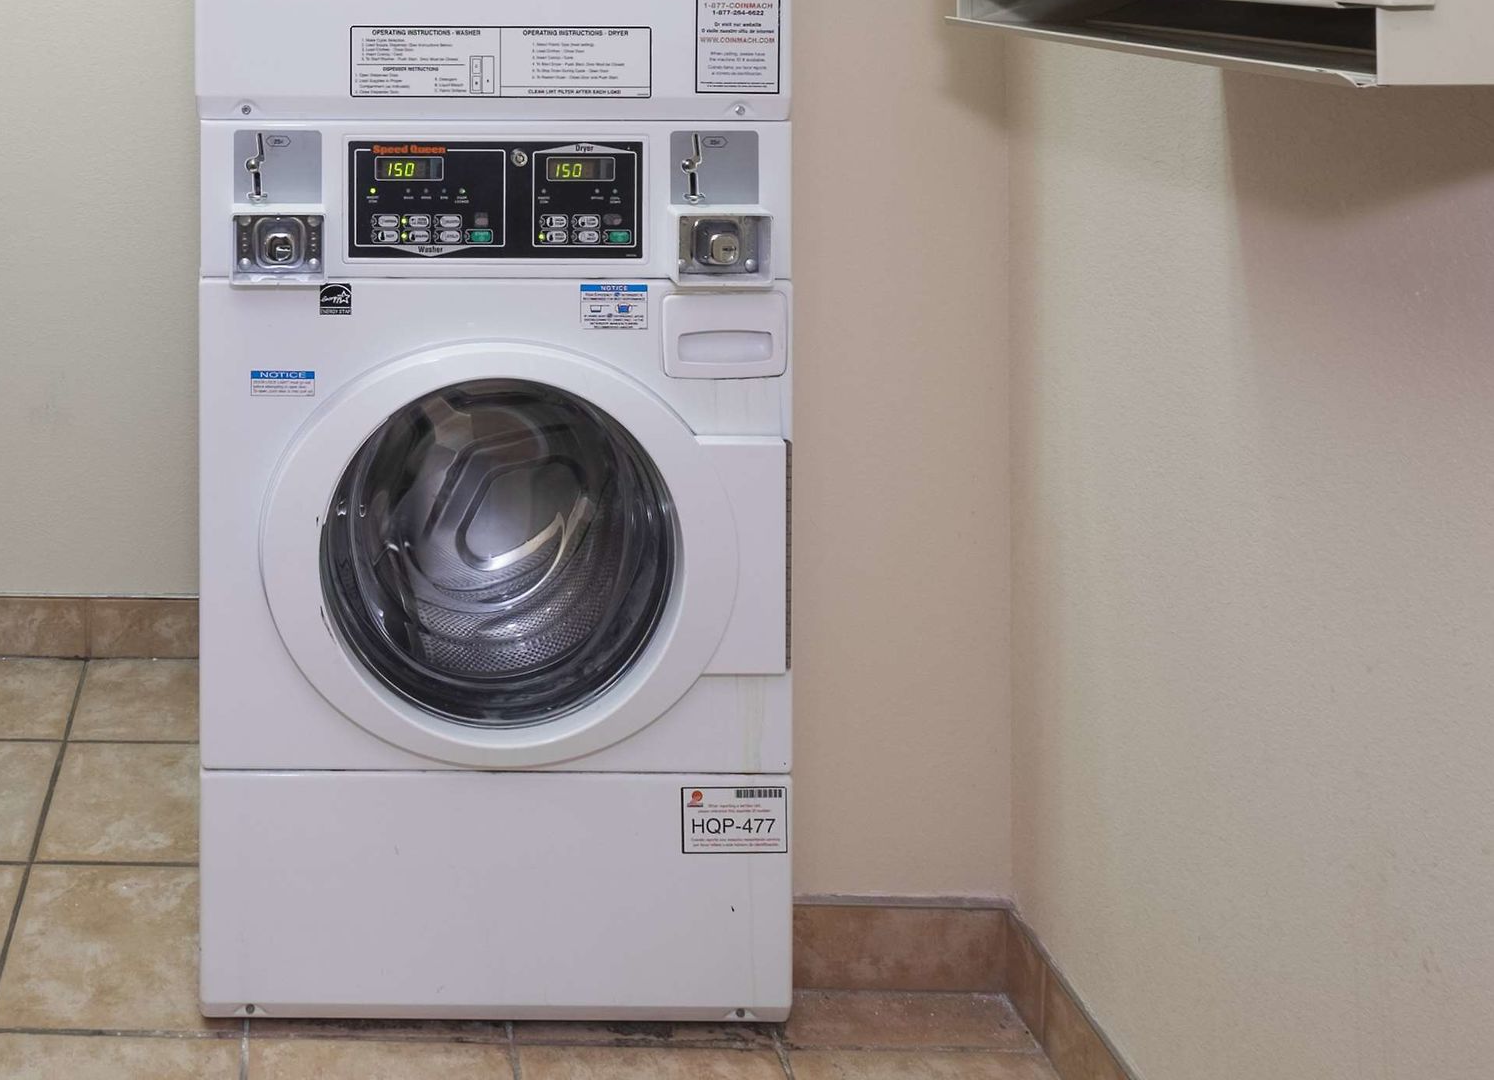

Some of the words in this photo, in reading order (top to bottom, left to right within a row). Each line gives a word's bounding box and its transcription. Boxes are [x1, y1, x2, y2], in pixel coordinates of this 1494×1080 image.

[373, 145, 408, 155] Speed
[410, 145, 446, 154] Queen
[575, 145, 594, 153] Dryer
[387, 163, 415, 177] 150
[555, 163, 582, 177] 150
[418, 245, 443, 254] Washer
[260, 371, 306, 379] NOTICE
[692, 818, 776, 834] HQP-477
